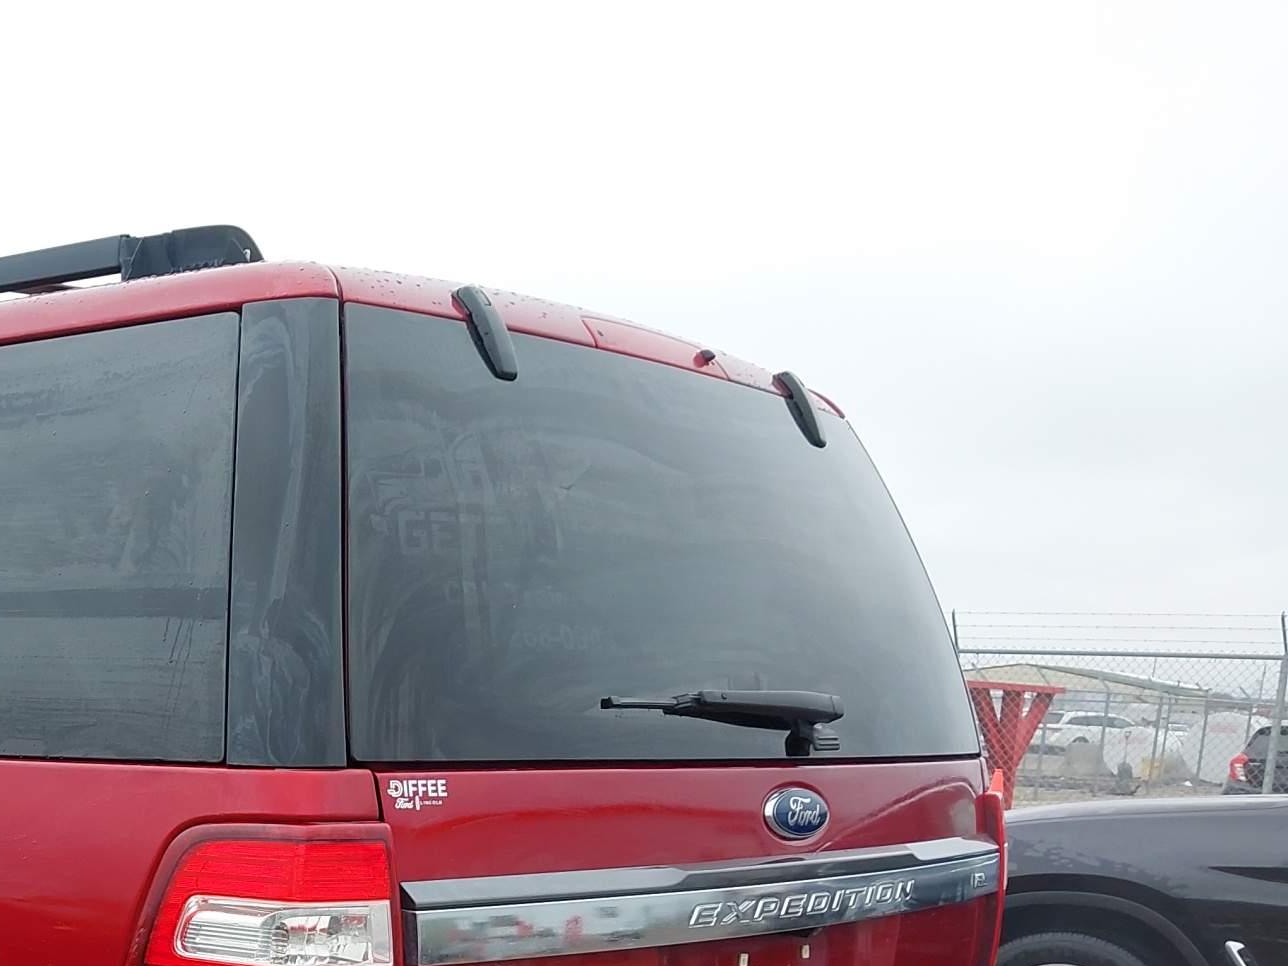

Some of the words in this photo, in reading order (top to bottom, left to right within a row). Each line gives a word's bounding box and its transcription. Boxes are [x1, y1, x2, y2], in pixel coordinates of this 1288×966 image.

[387, 779, 448, 797] DIFFEE
[787, 796, 821, 827] Ford
[688, 879, 915, 929] EXPEDITION
